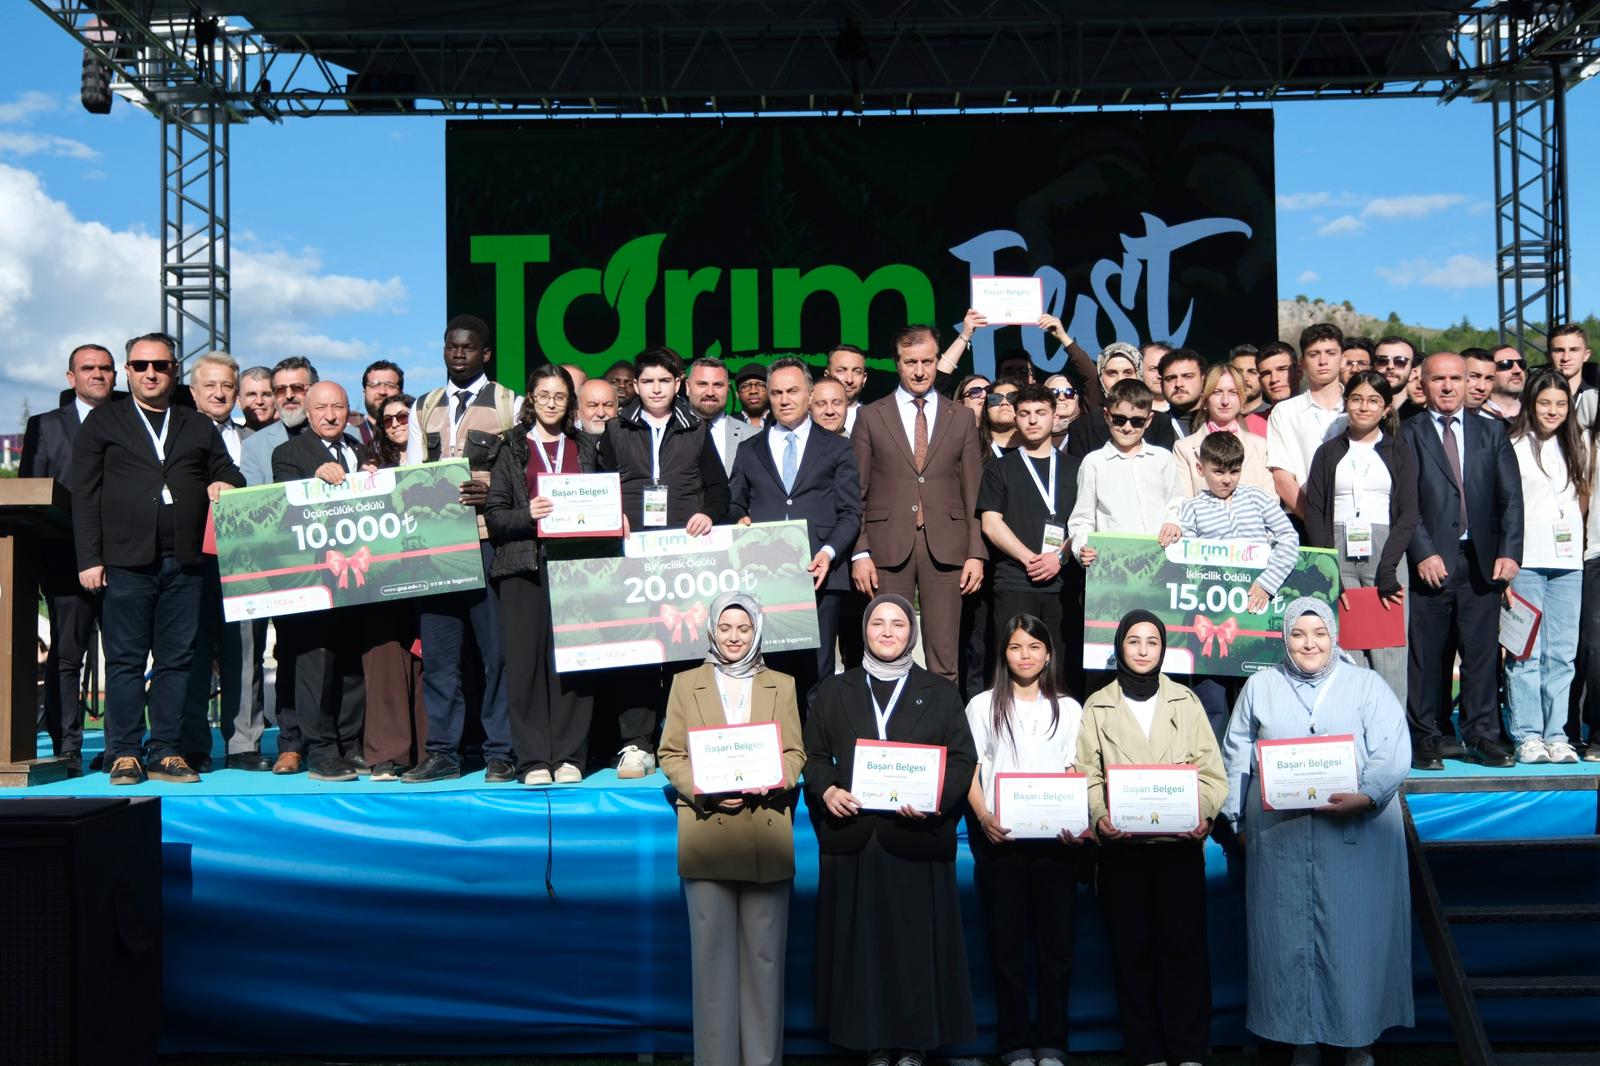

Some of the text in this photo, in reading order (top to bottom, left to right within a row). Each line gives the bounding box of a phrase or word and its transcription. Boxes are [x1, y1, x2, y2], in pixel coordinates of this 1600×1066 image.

[949, 212, 1252, 382] Fest
[552, 487, 608, 499] Başarı Belgesi
[303, 500, 385, 520] Üçüncülük Ödülü
[644, 556, 716, 572] Birincilik Ödülü
[1185, 568, 1251, 583] İkincilik Ödülü
[1166, 582, 1286, 615] 15.00₺
[704, 740, 765, 755] Başarı Belgesi
[866, 761, 926, 773] Başarı Belgesi
[1277, 757, 1342, 771] Başarı Belgesi
[1013, 792, 1075, 802] Başarı Belgesi
[1123, 784, 1185, 795] Başarı Belgesi
